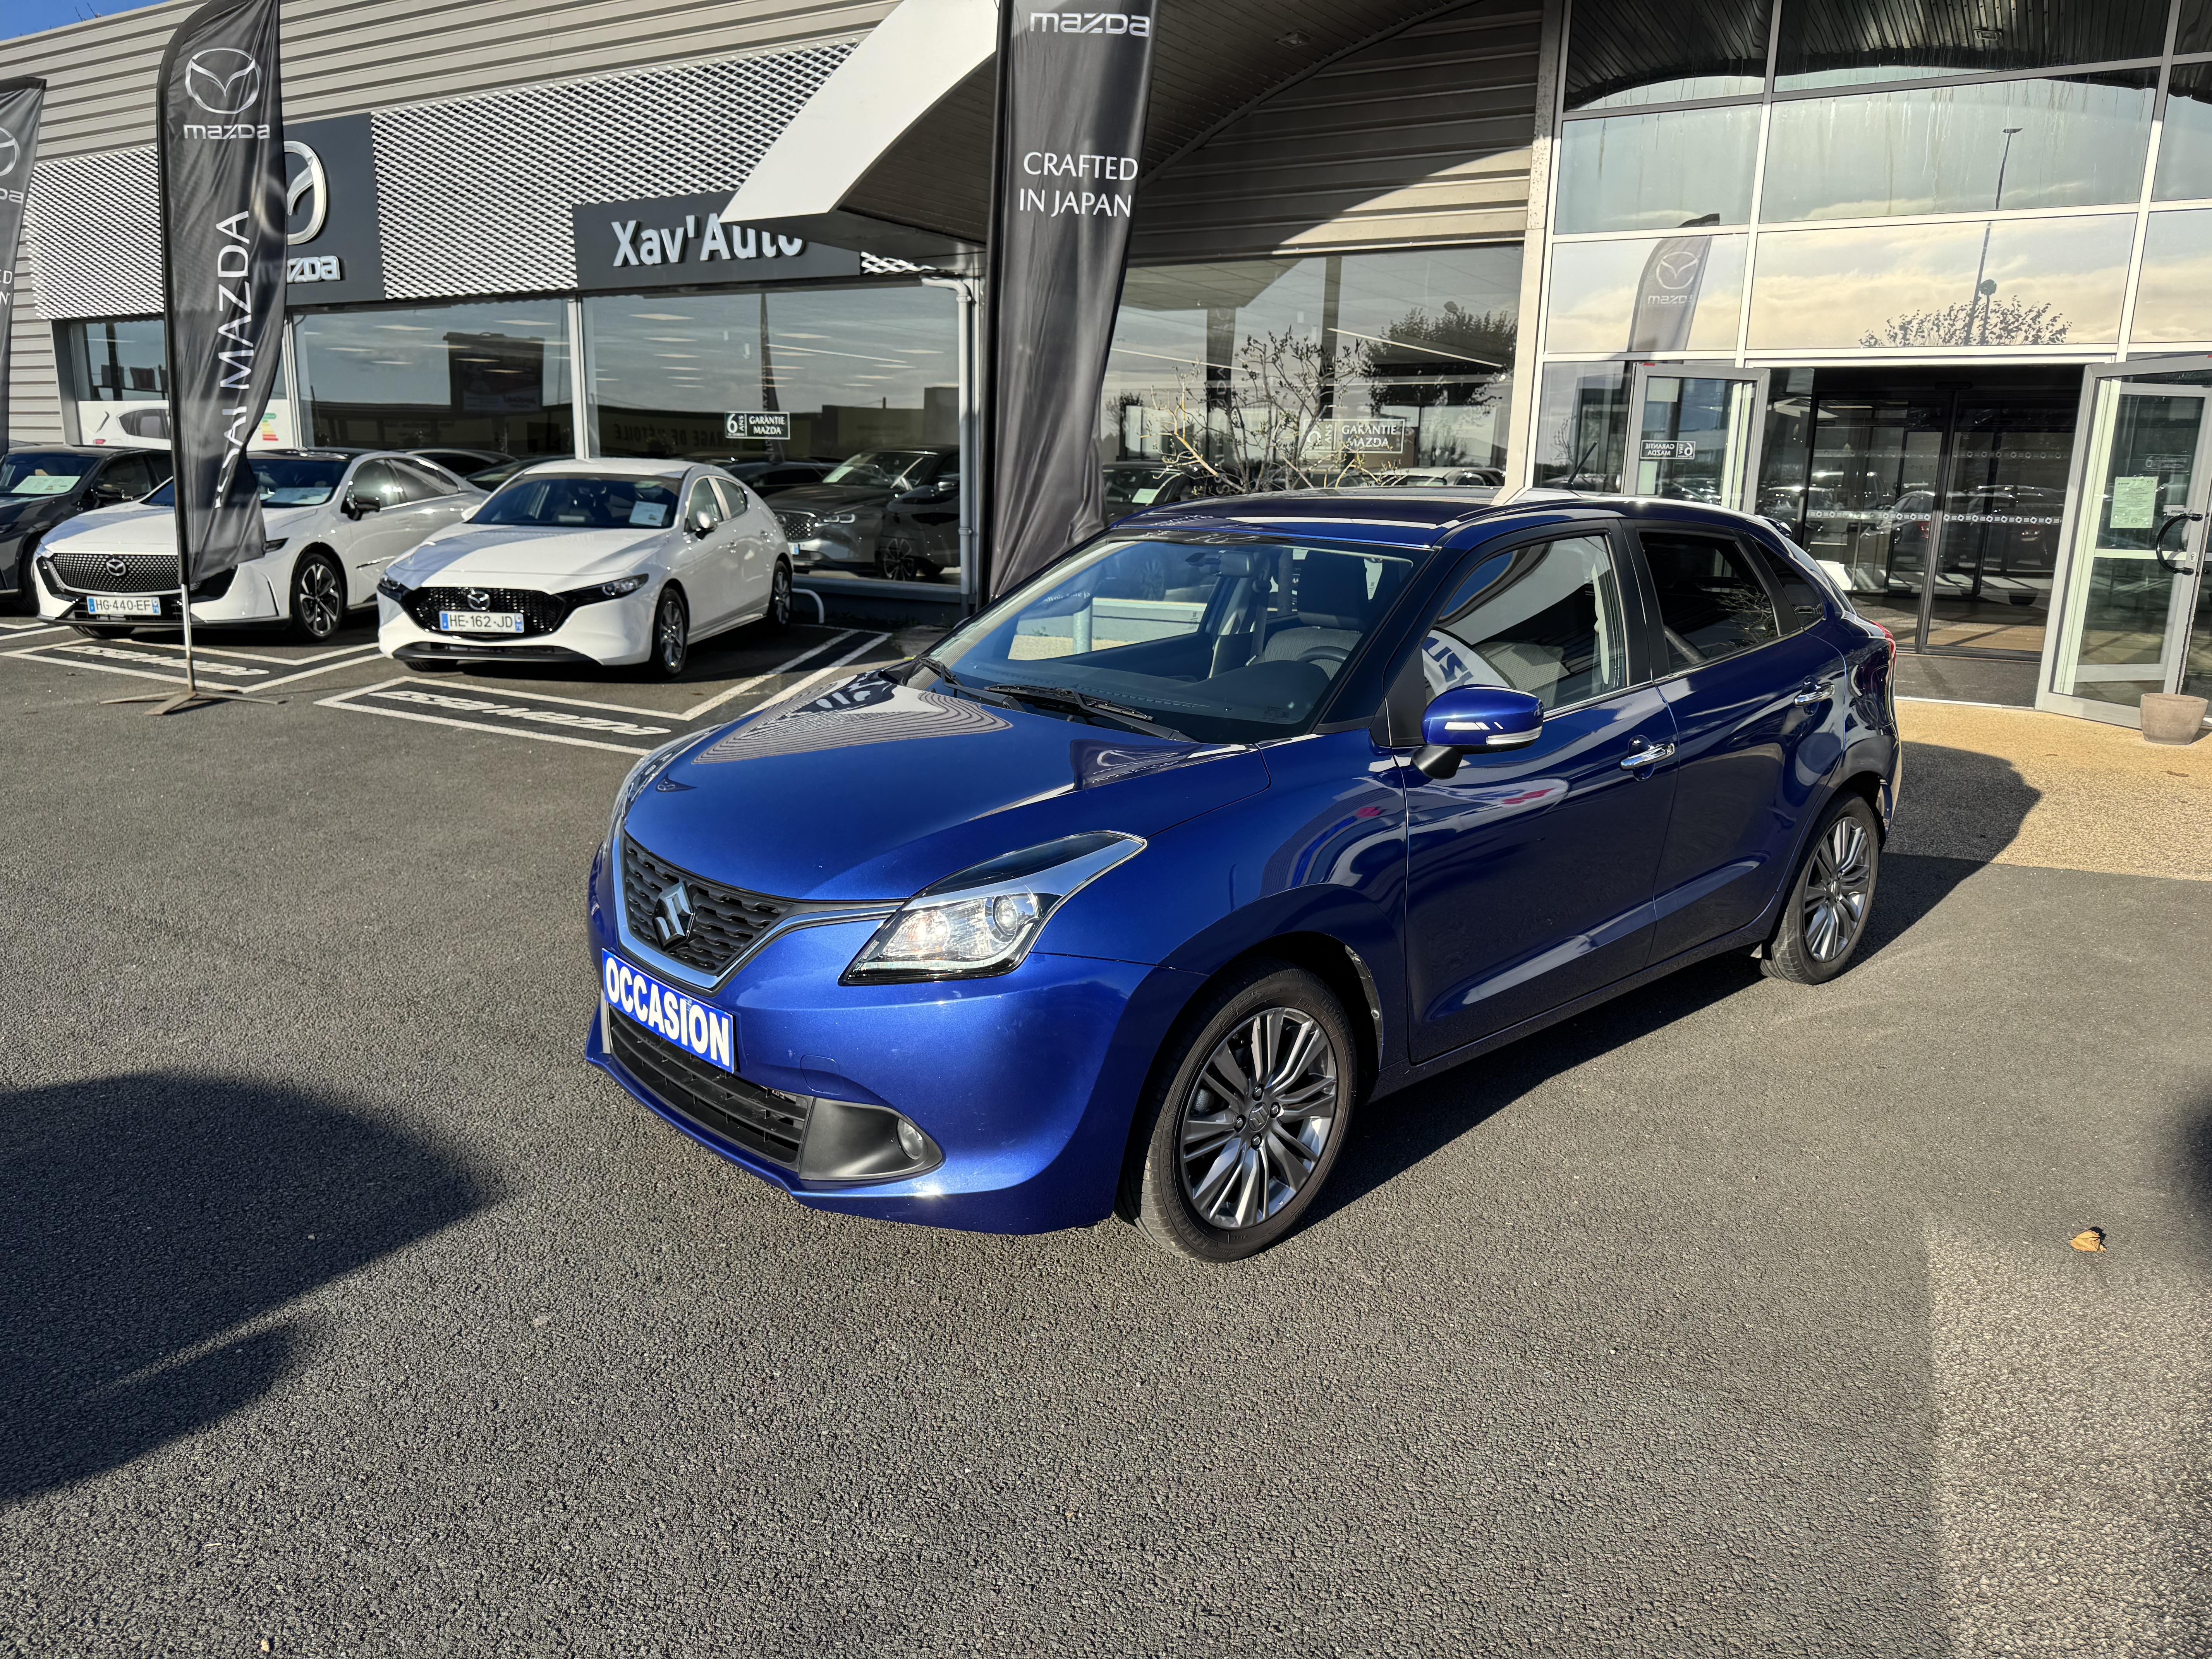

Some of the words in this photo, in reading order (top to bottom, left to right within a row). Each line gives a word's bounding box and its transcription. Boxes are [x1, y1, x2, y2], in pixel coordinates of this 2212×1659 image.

[1024, 152, 1138, 180] CRAFTED
[1020, 188, 1045, 212] IN
[1051, 190, 1131, 217] JAPAN
[216, 210, 254, 390] MAZDA
[726, 414, 738, 433] 6
[749, 415, 785, 425] GARANTIE
[753, 426, 782, 434] MAZDA
[1324, 424, 1333, 443] ANS
[1341, 425, 1396, 435] GARANTIE
[1348, 438, 1389, 447] MAZDA
[96, 599, 150, 611] HG-440-EF
[449, 615, 513, 627] HE-162-JD
[606, 957, 730, 1066] OCCASION
